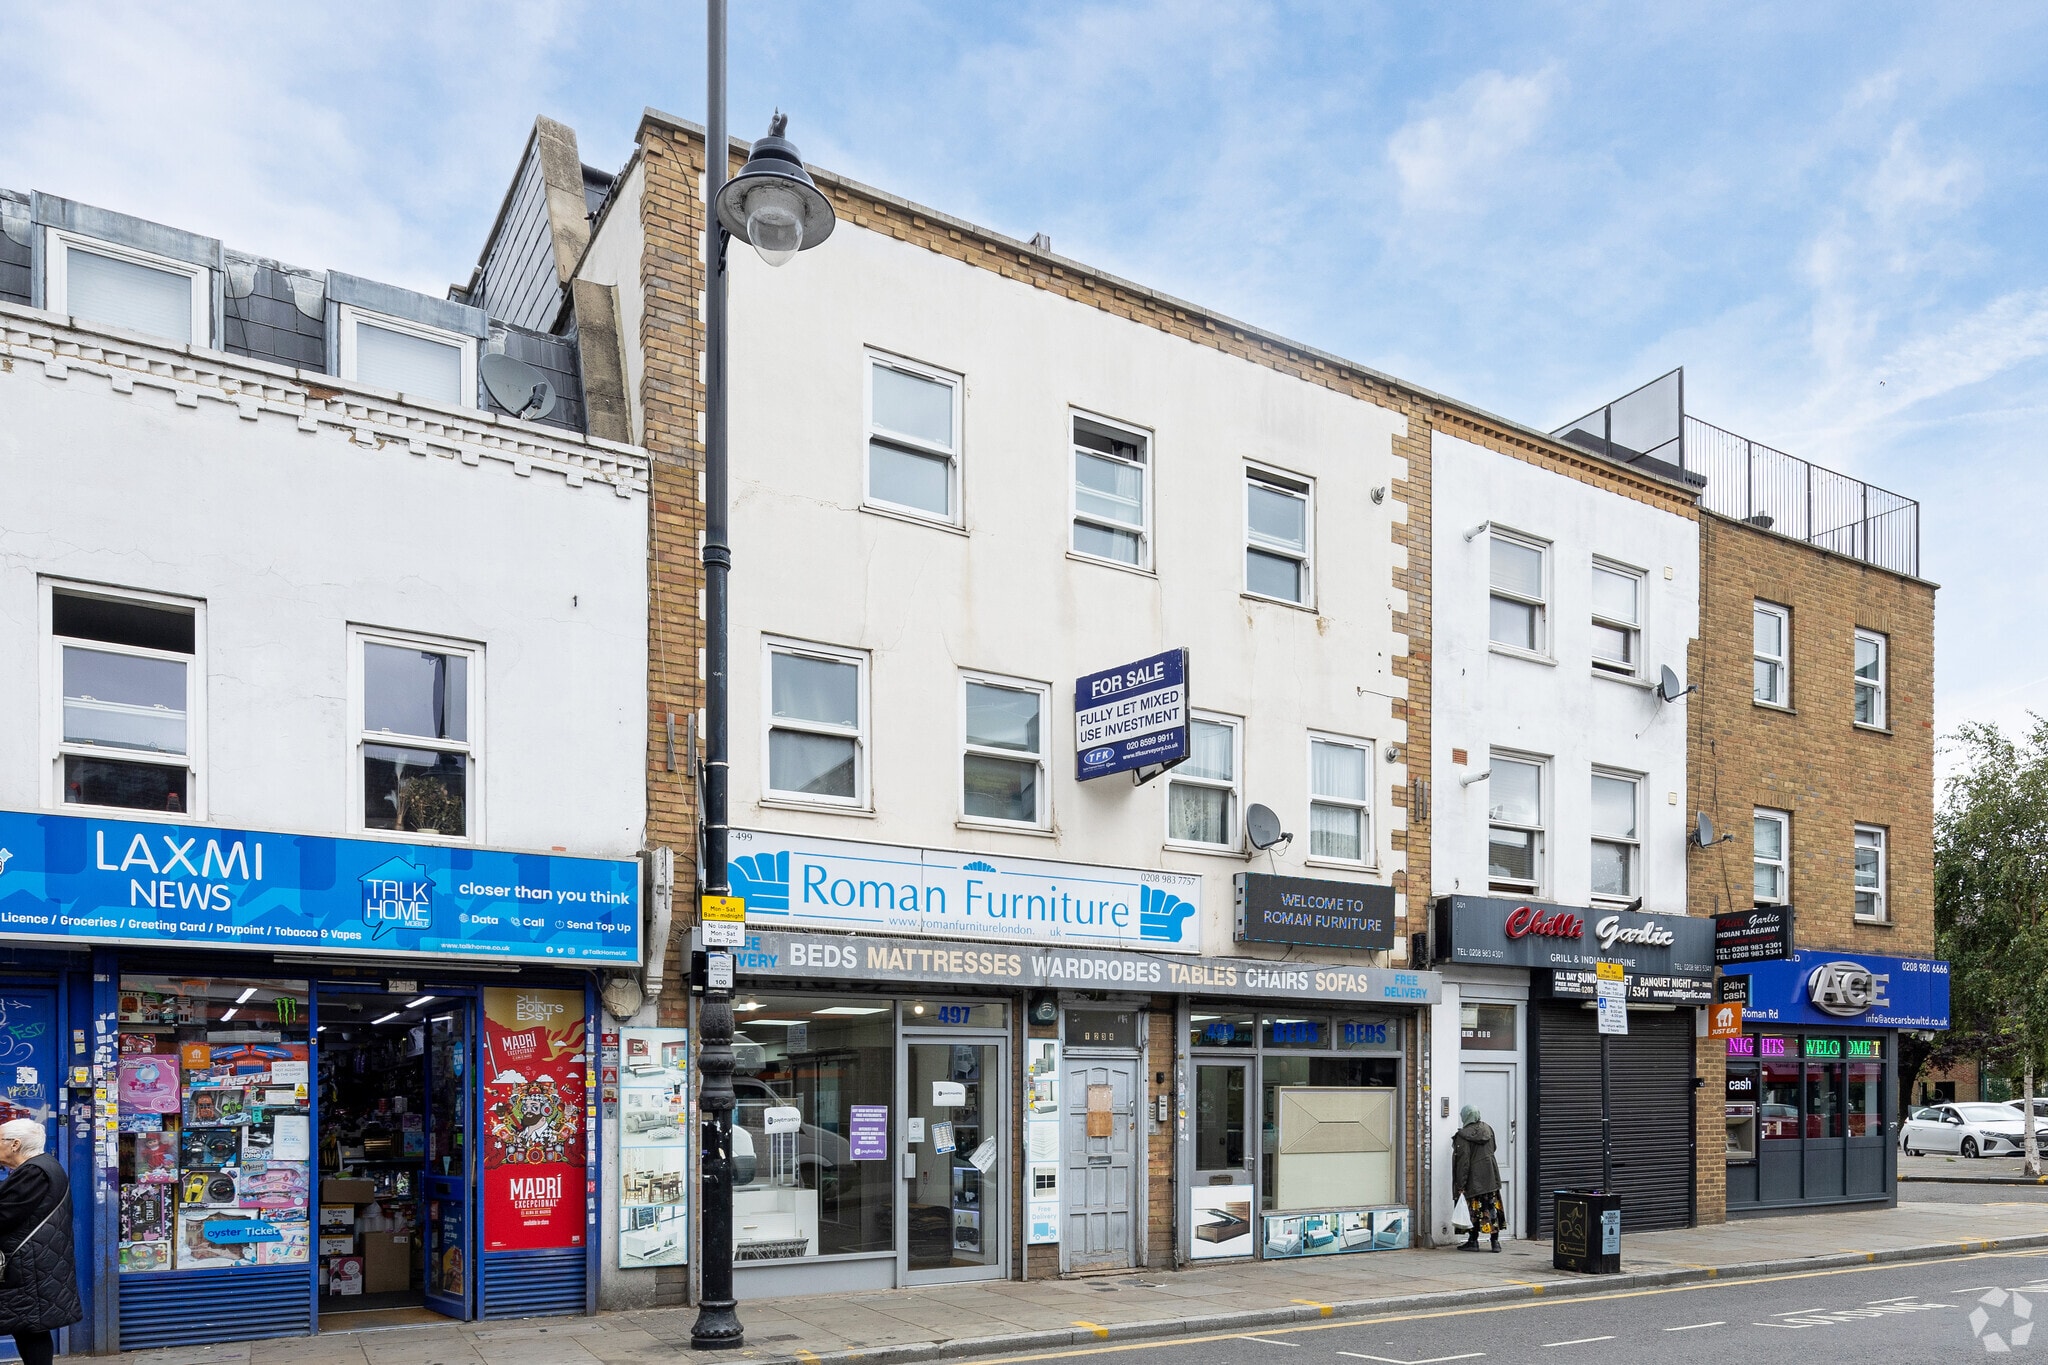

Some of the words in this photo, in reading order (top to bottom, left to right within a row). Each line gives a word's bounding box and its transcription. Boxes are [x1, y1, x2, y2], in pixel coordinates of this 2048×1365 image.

[1092, 675, 1122, 697] FOR
[1126, 661, 1164, 687] SALE
[1080, 707, 1113, 727] FULLY
[1117, 701, 1137, 717] LET
[1140, 690, 1179, 712] MIXED
[1080, 727, 1102, 743] USE
[1105, 707, 1180, 737] INVESTMENT
[1126, 741, 1139, 750] 020
[1157, 732, 1174, 744] 9911
[1089, 749, 1109, 763] TFK
[735, 832, 753, 842] 499
[96, 830, 263, 881] LAXMI
[1140, 873, 1161, 883] 0208
[1162, 875, 1177, 885] 983
[1177, 876, 1197, 887] 7757
[130, 878, 231, 912] NEWS
[367, 879, 429, 902] TALK
[459, 881, 512, 899] closer
[514, 883, 553, 901] than
[556, 890, 588, 906] you
[590, 889, 630, 905] think
[803, 863, 947, 915] Roman
[965, 879, 1130, 928] Furniture
[367, 899, 430, 921] HOME
[1281, 892, 1344, 912] WELCOME
[1346, 899, 1364, 913] TO
[1, 912, 49, 926] Licence
[60, 915, 118, 929] Groceries
[128, 918, 177, 934] Greeting
[180, 921, 206, 934] Card
[216, 923, 265, 937] Paypoint
[275, 926, 319, 939] Tobacco
[320, 928, 329, 939] &
[331, 929, 362, 941] Vapes
[404, 920, 430, 928] MOBILE
[471, 914, 499, 925] Data
[522, 917, 545, 928] Call
[566, 919, 594, 930] Send
[596, 922, 615, 933] Top
[616, 923, 632, 934] Up
[1263, 909, 1312, 928] ROMAN
[1315, 914, 1382, 932] FURNITURE
[1748, 913, 1780, 928] Garlic
[1504, 906, 1584, 939] Chilli
[1595, 915, 1675, 951] Garlic
[1716, 930, 1741, 939] INDIAN
[1742, 925, 1780, 936] TAKEAWAY
[440, 942, 511, 952] www.talkhome.co.uk
[729, 935, 762, 951] EE
[1715, 947, 1731, 955] TEL:
[1766, 948, 1783, 956] 5341
[789, 942, 858, 969] BEDS
[866, 946, 1022, 977] MATTRESSES
[1031, 955, 1161, 983] WARDROBES
[1168, 963, 1237, 987] TABLES
[1245, 968, 1309, 991] CHAIRS
[1314, 972, 1368, 993] SOFAS
[1550, 953, 1572, 963] GRILL
[1574, 955, 1580, 963] &
[1581, 956, 1606, 965] INDIAN
[1607, 957, 1636, 967] CUISINE
[1902, 961, 1917, 972] 0208
[1917, 962, 1931, 973] 980
[1932, 964, 1948, 974] 6666
[1394, 973, 1418, 986] FREE
[1555, 972, 1566, 981] ALL
[1566, 973, 1577, 981] DAY
[1577, 973, 1596, 984] SUND
[1640, 977, 1671, 988] BANQUET
[1671, 978, 1692, 989] NIGHT
[1723, 981, 1746, 991] 24hr
[1811, 963, 1890, 1008] ACE
[1384, 986, 1428, 999] DELIVERY
[1632, 986, 1649, 998] 5341
[1653, 988, 1712, 1000] www.chilligarlic.com
[1723, 989, 1746, 1000] cash
[516, 1003, 564, 1013] POINTS
[937, 1006, 971, 1024] 497
[1741, 1008, 1767, 1019] Roman
[1769, 1009, 1779, 1019] Rd
[1865, 1013, 1948, 1027] info@acecarsbowltd.co.uk
[1206, 1023, 1235, 1040] 499
[1273, 1022, 1319, 1043] BEDS
[1344, 1024, 1387, 1044] BEDS
[1712, 1028, 1726, 1036] JUST
[502, 1031, 537, 1051] MADRÍ
[1729, 1077, 1752, 1090] cash
[510, 1173, 562, 1201] MADRÍ
[514, 1200, 557, 1209] EXCEPCIONAL
[208, 1229, 241, 1239] oyster
[245, 1227, 279, 1236] Ticket
